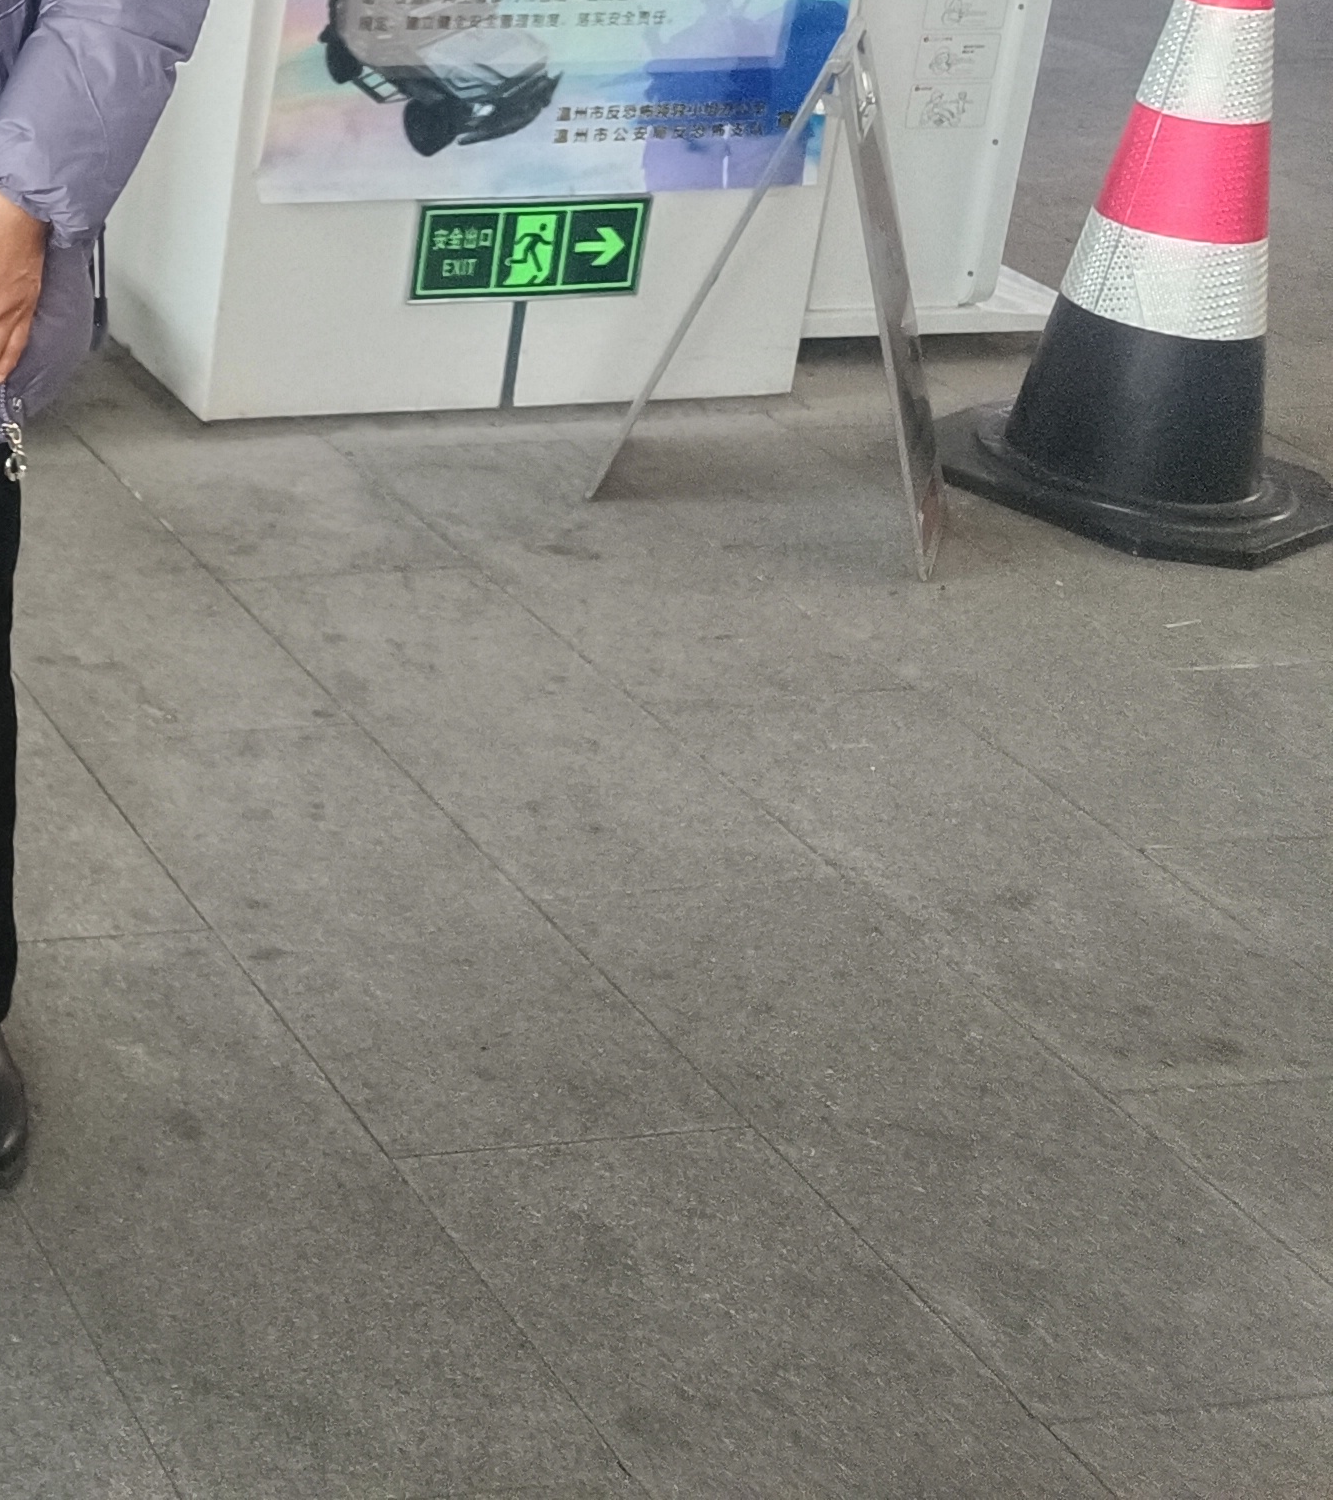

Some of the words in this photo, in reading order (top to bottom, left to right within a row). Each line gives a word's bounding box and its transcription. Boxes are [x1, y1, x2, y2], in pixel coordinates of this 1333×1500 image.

[433, 227, 494, 251] 安全出口
[442, 258, 477, 277] EXIT
